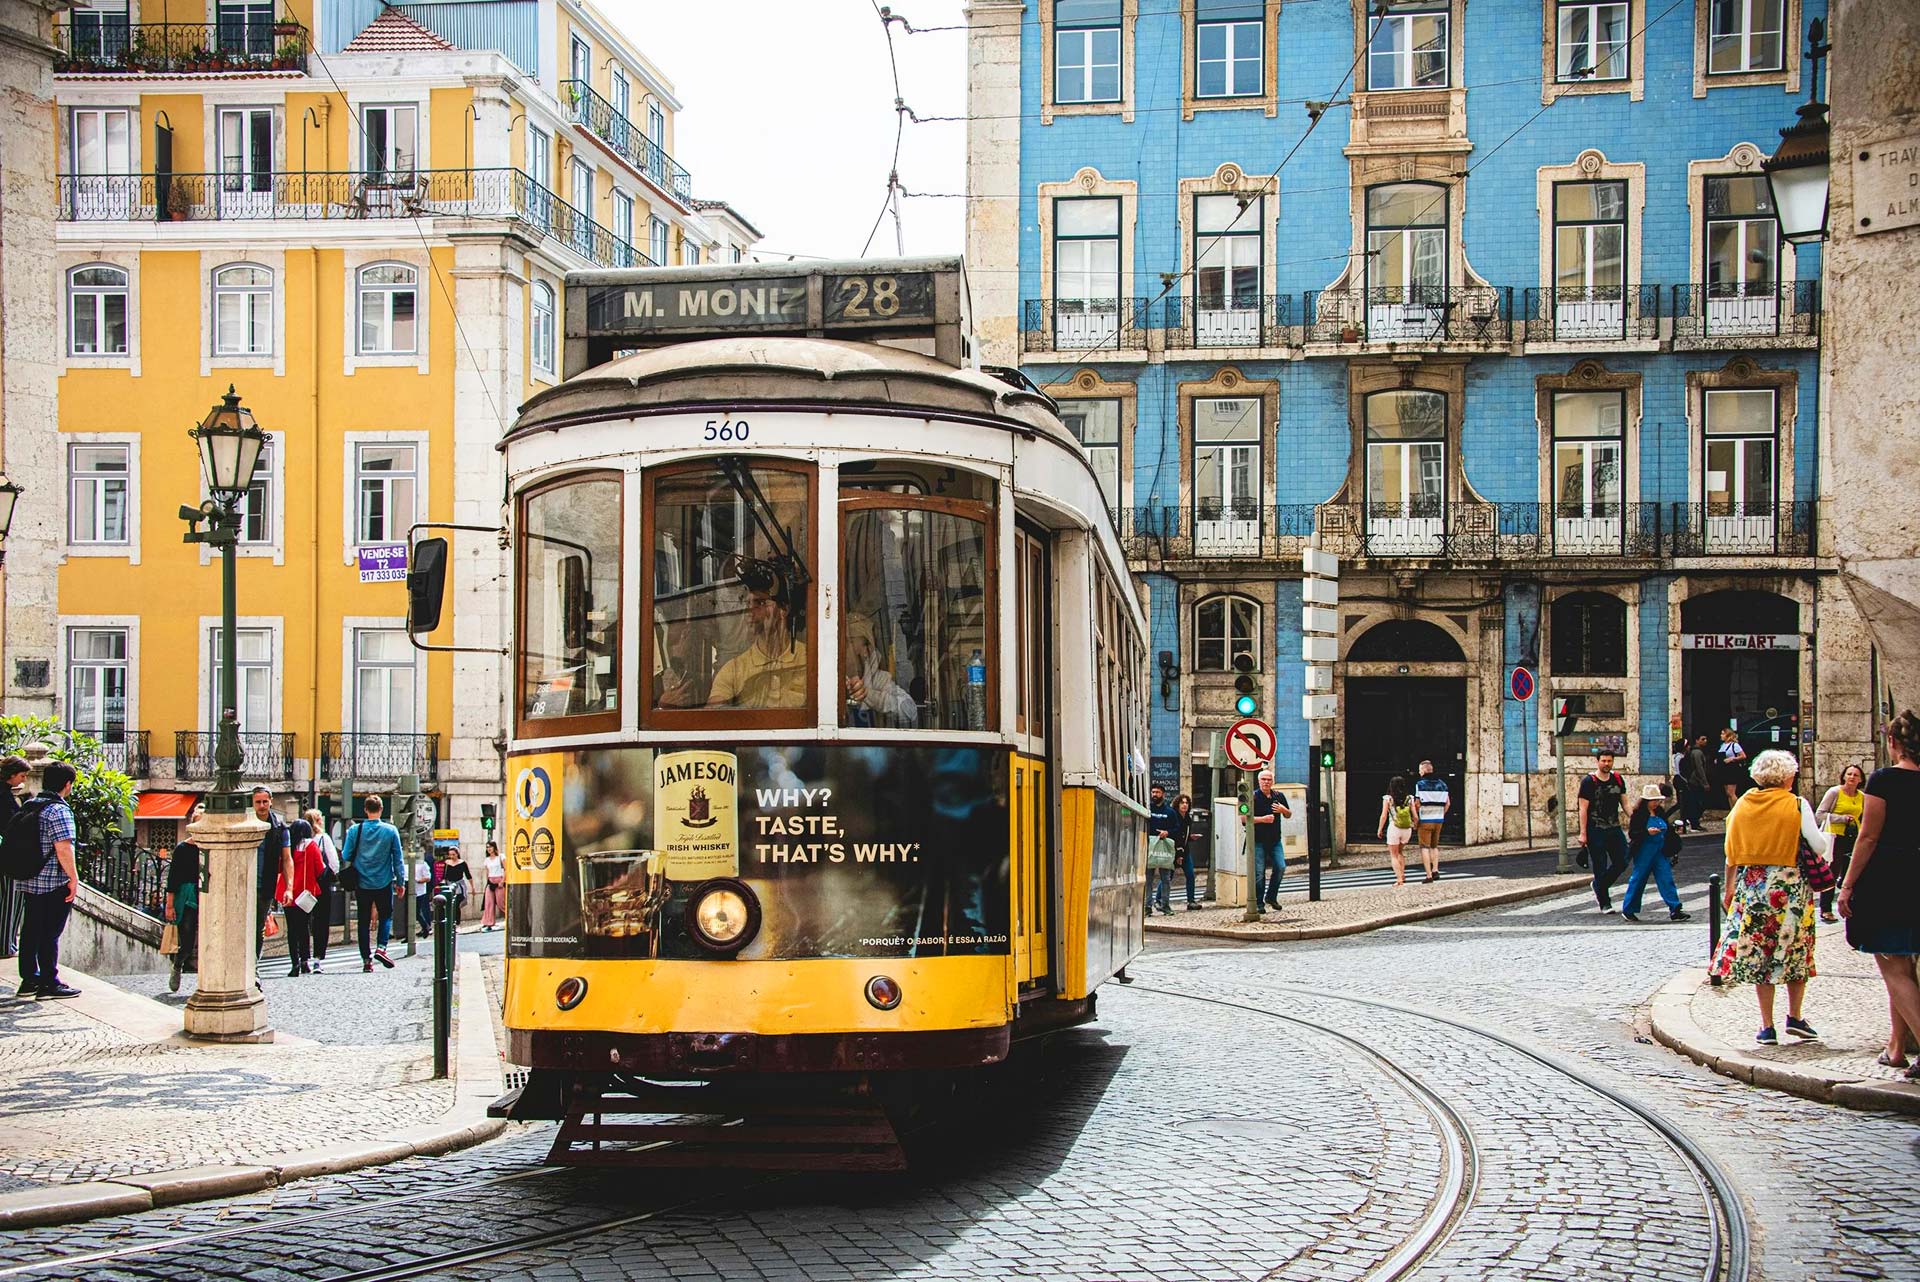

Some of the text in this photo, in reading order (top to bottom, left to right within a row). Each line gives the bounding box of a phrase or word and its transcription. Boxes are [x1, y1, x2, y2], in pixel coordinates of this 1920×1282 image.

[623, 276, 900, 318] M. MONIZ 28
[704, 420, 750, 441] 560
[361, 547, 404, 559] VENDE-SE
[377, 559, 388, 569] T2
[361, 570, 406, 581] 917 333 035
[1695, 635, 1734, 648] FOLK
[1747, 635, 1776, 648] ART
[532, 701, 547, 715] 08
[660, 761, 735, 788] JAMESON
[755, 788, 832, 807] WHY?
[755, 816, 845, 838] TASTE,
[692, 843, 730, 851] WHISKEY
[755, 844, 845, 863] THAT’S
[907, 937, 913, 945] O
[949, 935, 953, 944] É
[956, 936, 975, 944] ESSA
[984, 933, 1007, 943] RAZÃO
